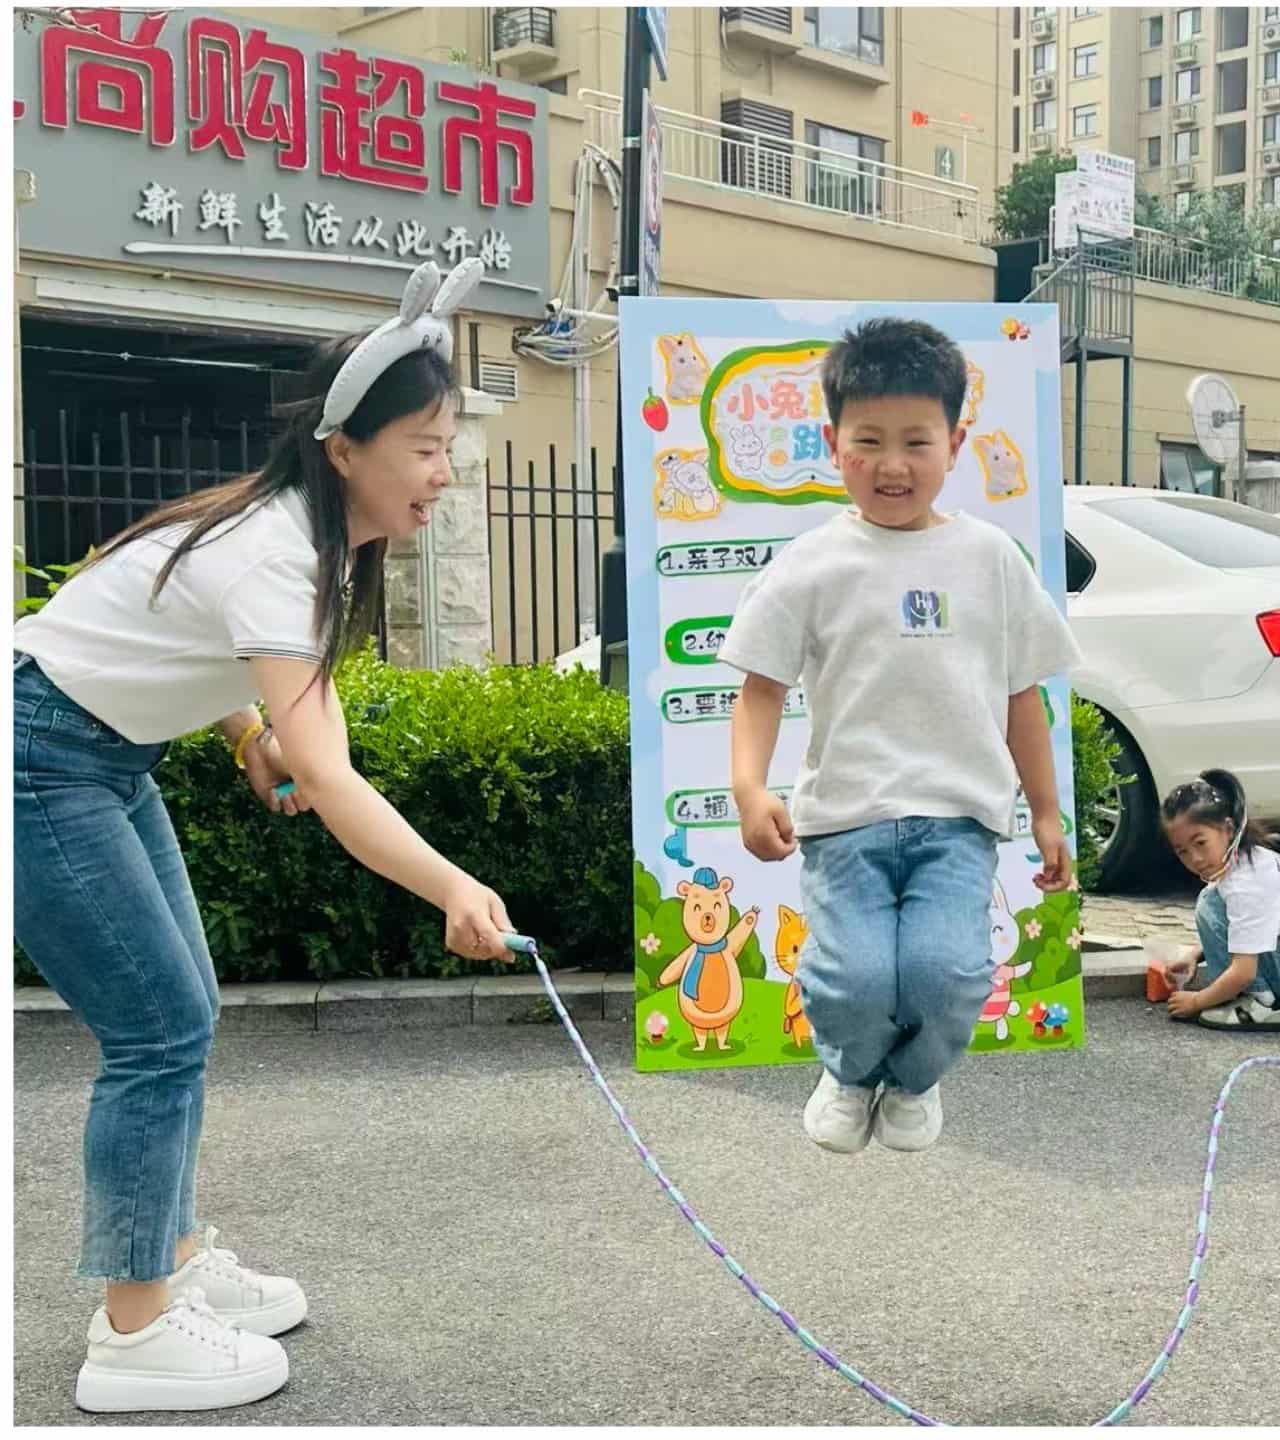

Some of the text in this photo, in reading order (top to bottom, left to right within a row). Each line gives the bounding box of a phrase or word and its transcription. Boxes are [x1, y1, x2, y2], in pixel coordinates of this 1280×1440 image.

[40, 7, 536, 207] 尚购超市
[134, 181, 514, 272] 新鲜生活从此开始
